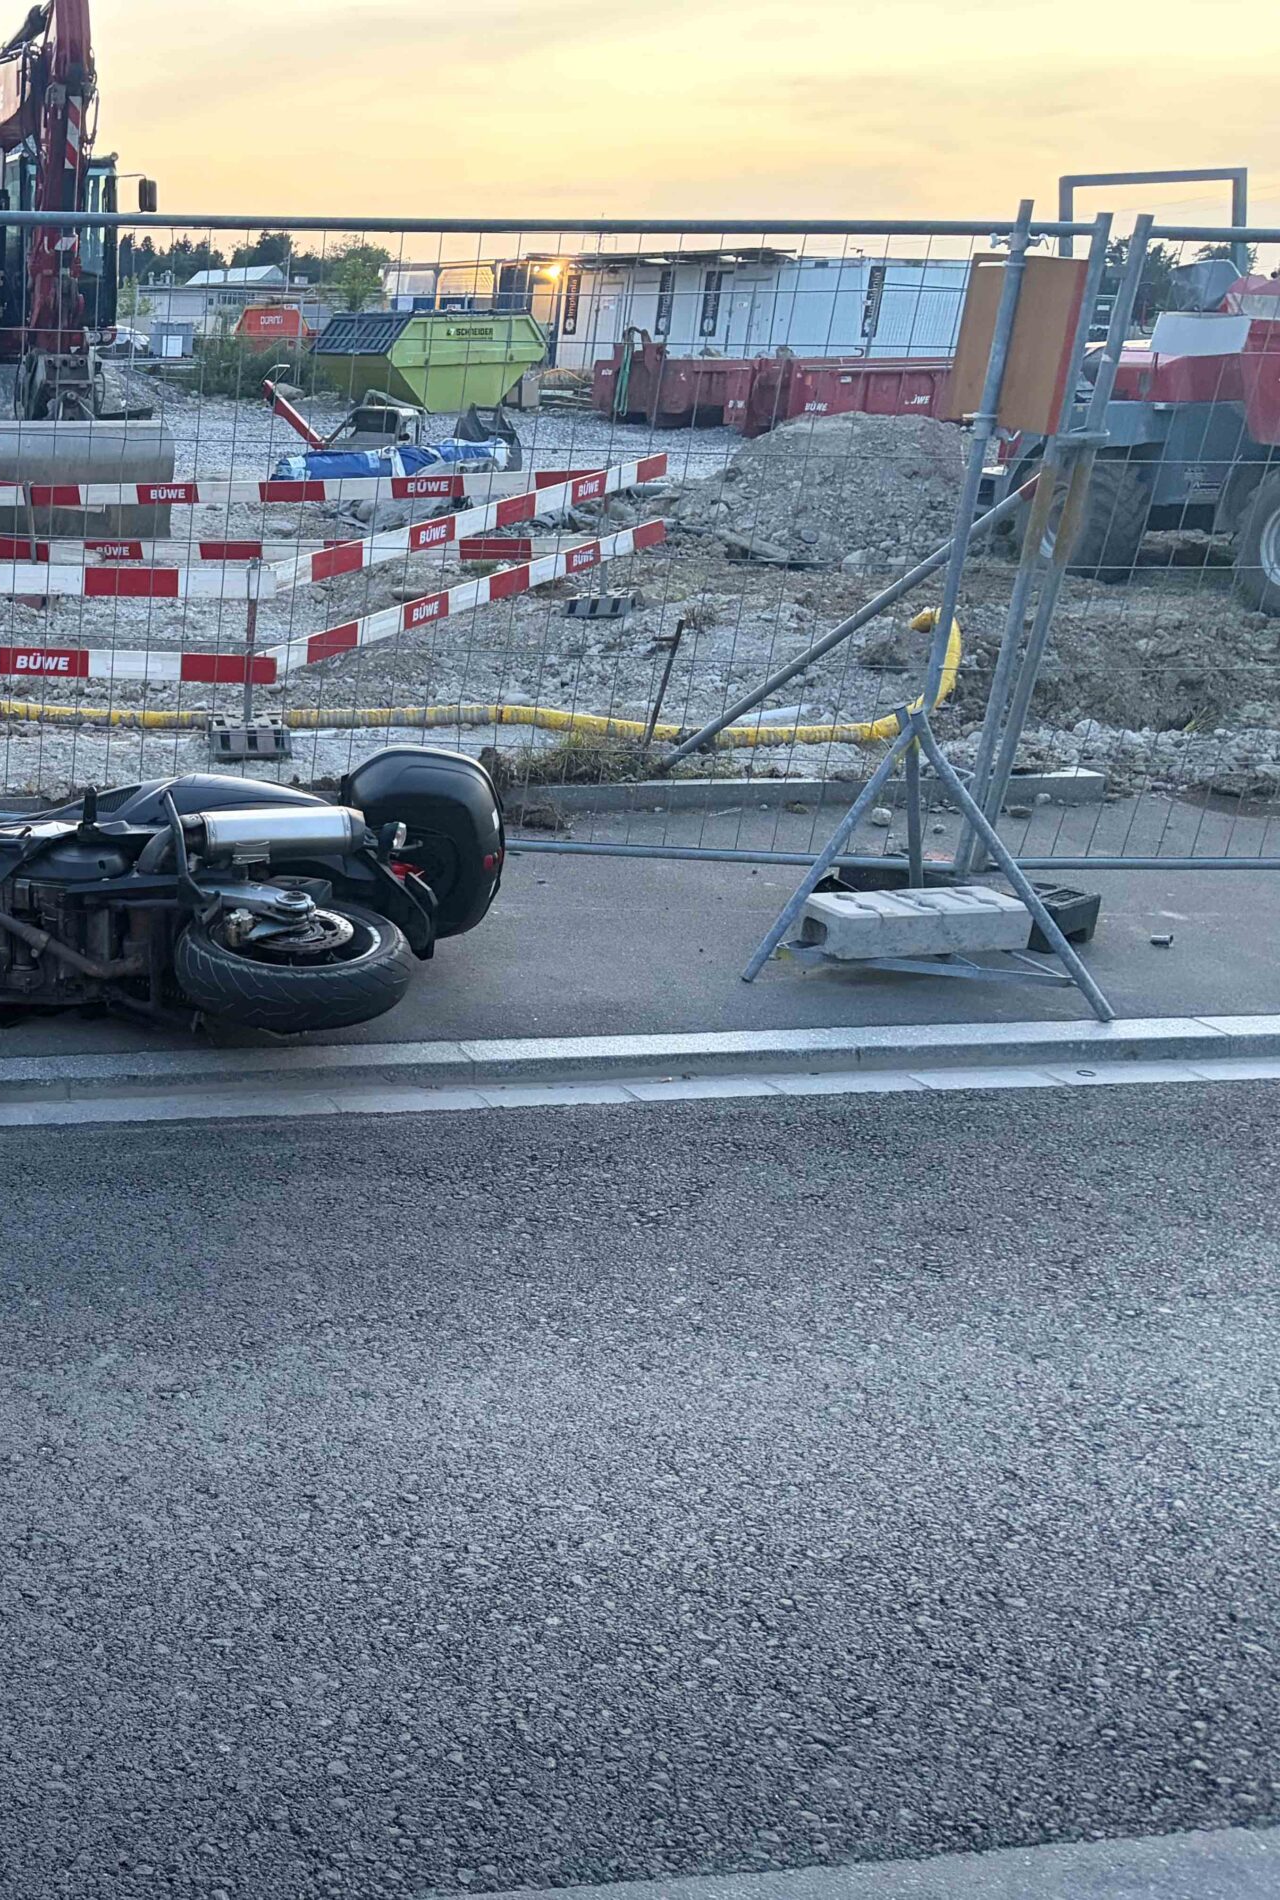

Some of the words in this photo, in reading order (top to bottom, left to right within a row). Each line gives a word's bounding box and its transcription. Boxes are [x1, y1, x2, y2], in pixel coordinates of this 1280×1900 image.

[150, 487, 186, 500] BÜWE
[407, 478, 449, 493] BÜWE
[578, 480, 600, 497] BÜWE
[419, 524, 448, 545] BÜWE
[572, 548, 595, 567] BÜWE
[412, 601, 440, 623] BÜWE
[15, 652, 70, 671] BÜWE
